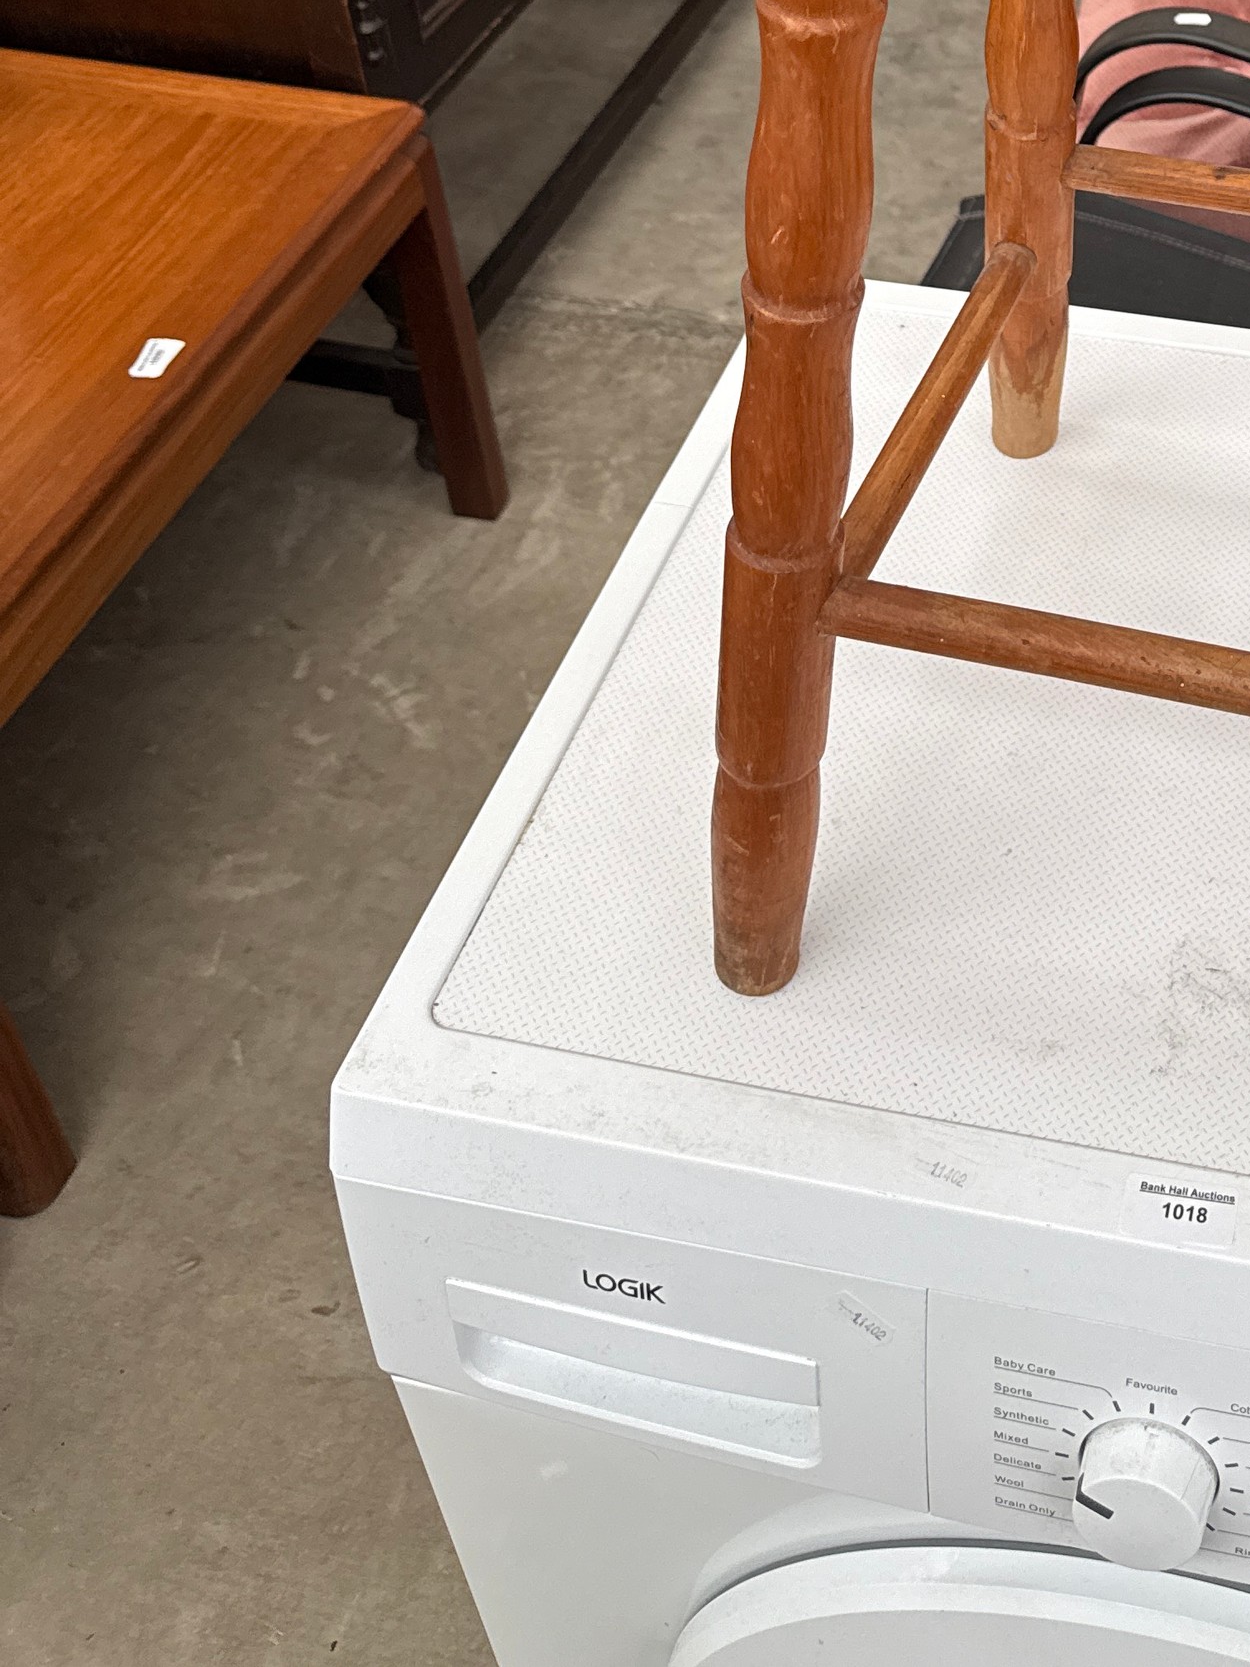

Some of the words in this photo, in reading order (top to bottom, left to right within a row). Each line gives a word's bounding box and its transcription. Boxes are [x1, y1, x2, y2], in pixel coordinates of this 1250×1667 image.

[1140, 1181, 1166, 1192] Bank
[1169, 1185, 1189, 1196] Hall
[1190, 1188, 1235, 1203] Auctions
[1162, 1202, 1208, 1223] 1018
[582, 1269, 666, 1304] LOGIK
[994, 1356, 1024, 1372] Baby
[1027, 1363, 1056, 1376] Care
[994, 1382, 1033, 1397] Sports
[1125, 1377, 1178, 1396] Favourite
[993, 1406, 1050, 1426] Synthetic
[993, 1430, 1029, 1445] Mixed
[993, 1453, 1042, 1470] Delicate
[995, 1474, 1025, 1488] Wool
[994, 1496, 1026, 1510] Drain
[1028, 1504, 1057, 1517] Only
